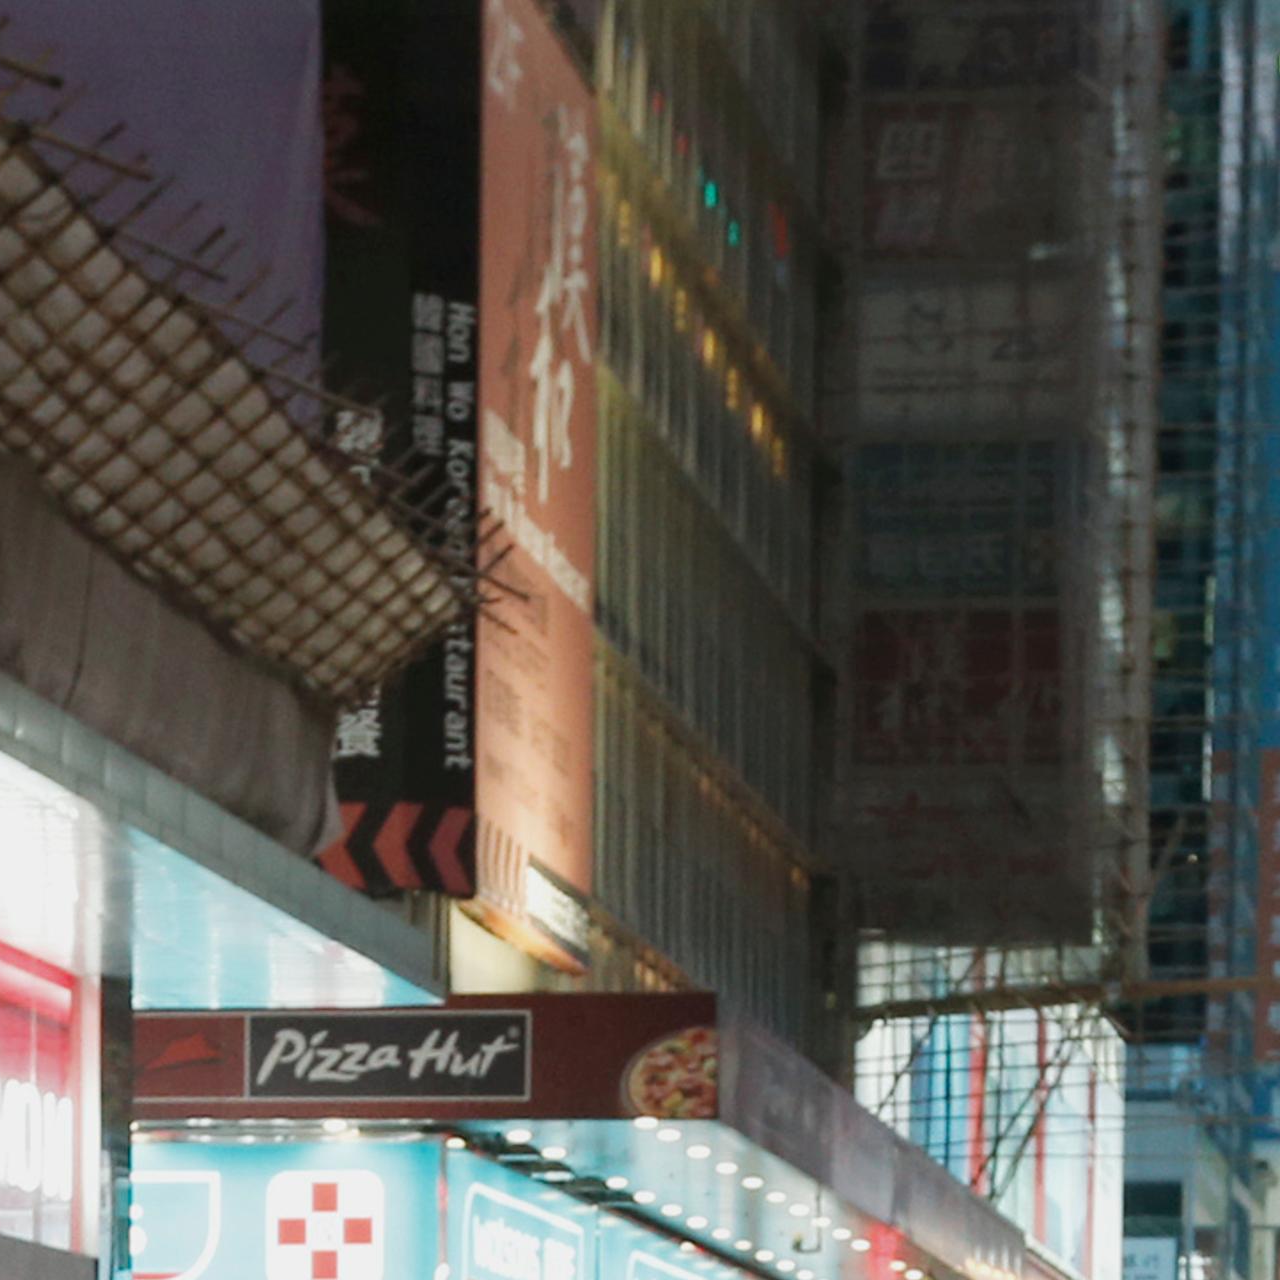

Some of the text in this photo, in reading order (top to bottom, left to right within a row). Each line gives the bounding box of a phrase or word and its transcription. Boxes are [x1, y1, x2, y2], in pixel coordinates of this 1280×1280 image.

[446, 302, 475, 362] Hon
[446, 381, 475, 421] Wo
[257, 1028, 520, 1085] Pizza Hut
